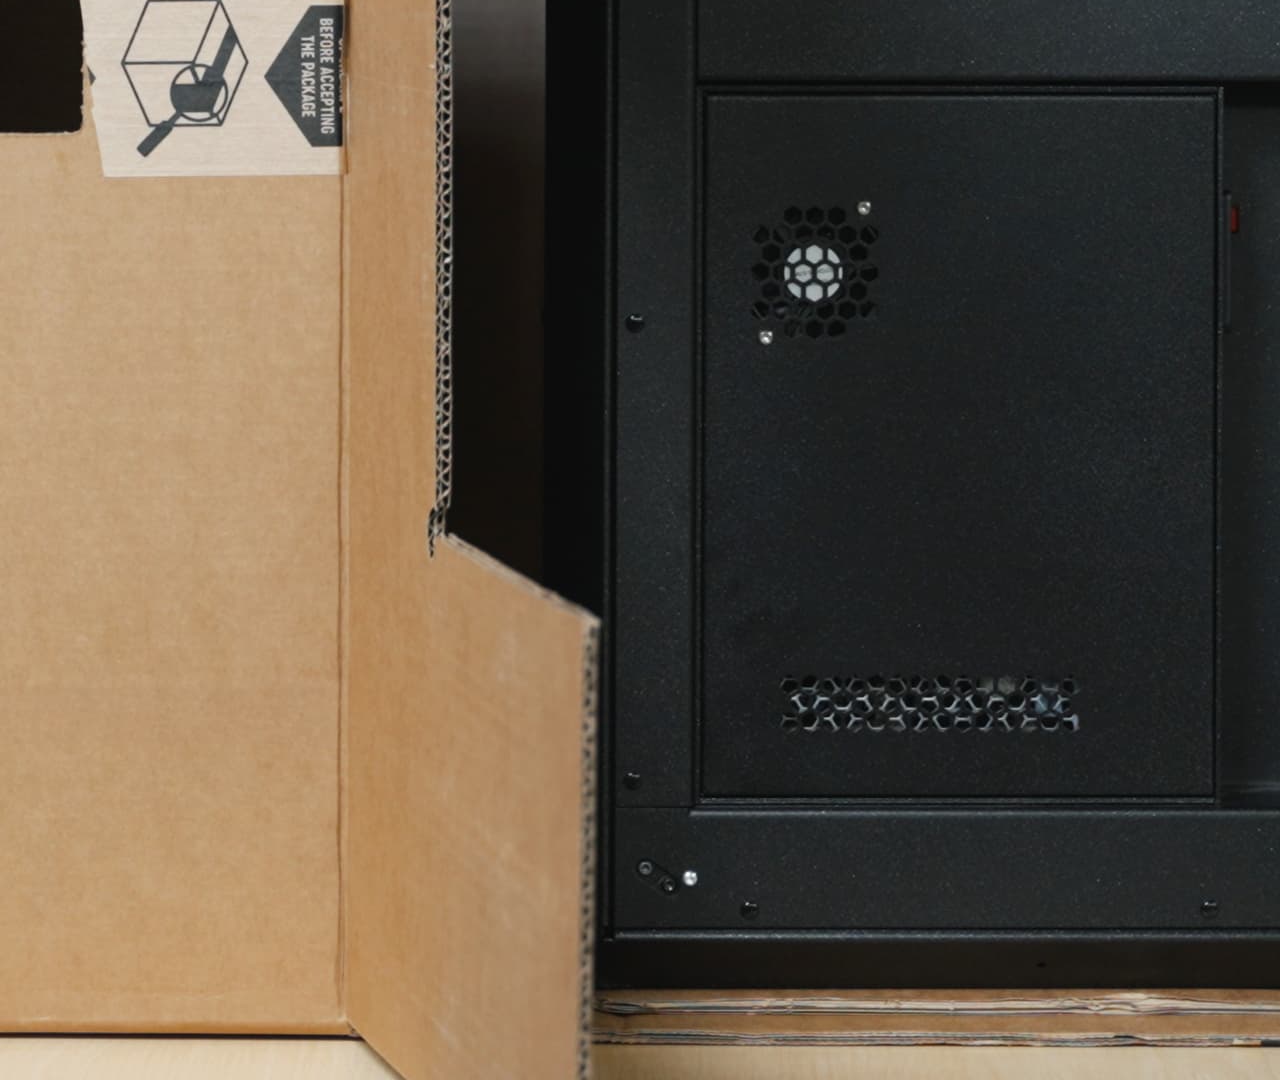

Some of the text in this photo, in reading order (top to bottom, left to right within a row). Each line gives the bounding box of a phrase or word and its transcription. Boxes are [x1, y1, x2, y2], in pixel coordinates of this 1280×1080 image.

[301, 35, 316, 117] THE PACKAGE
[319, 17, 335, 134] BEFORE ACCEPTING
